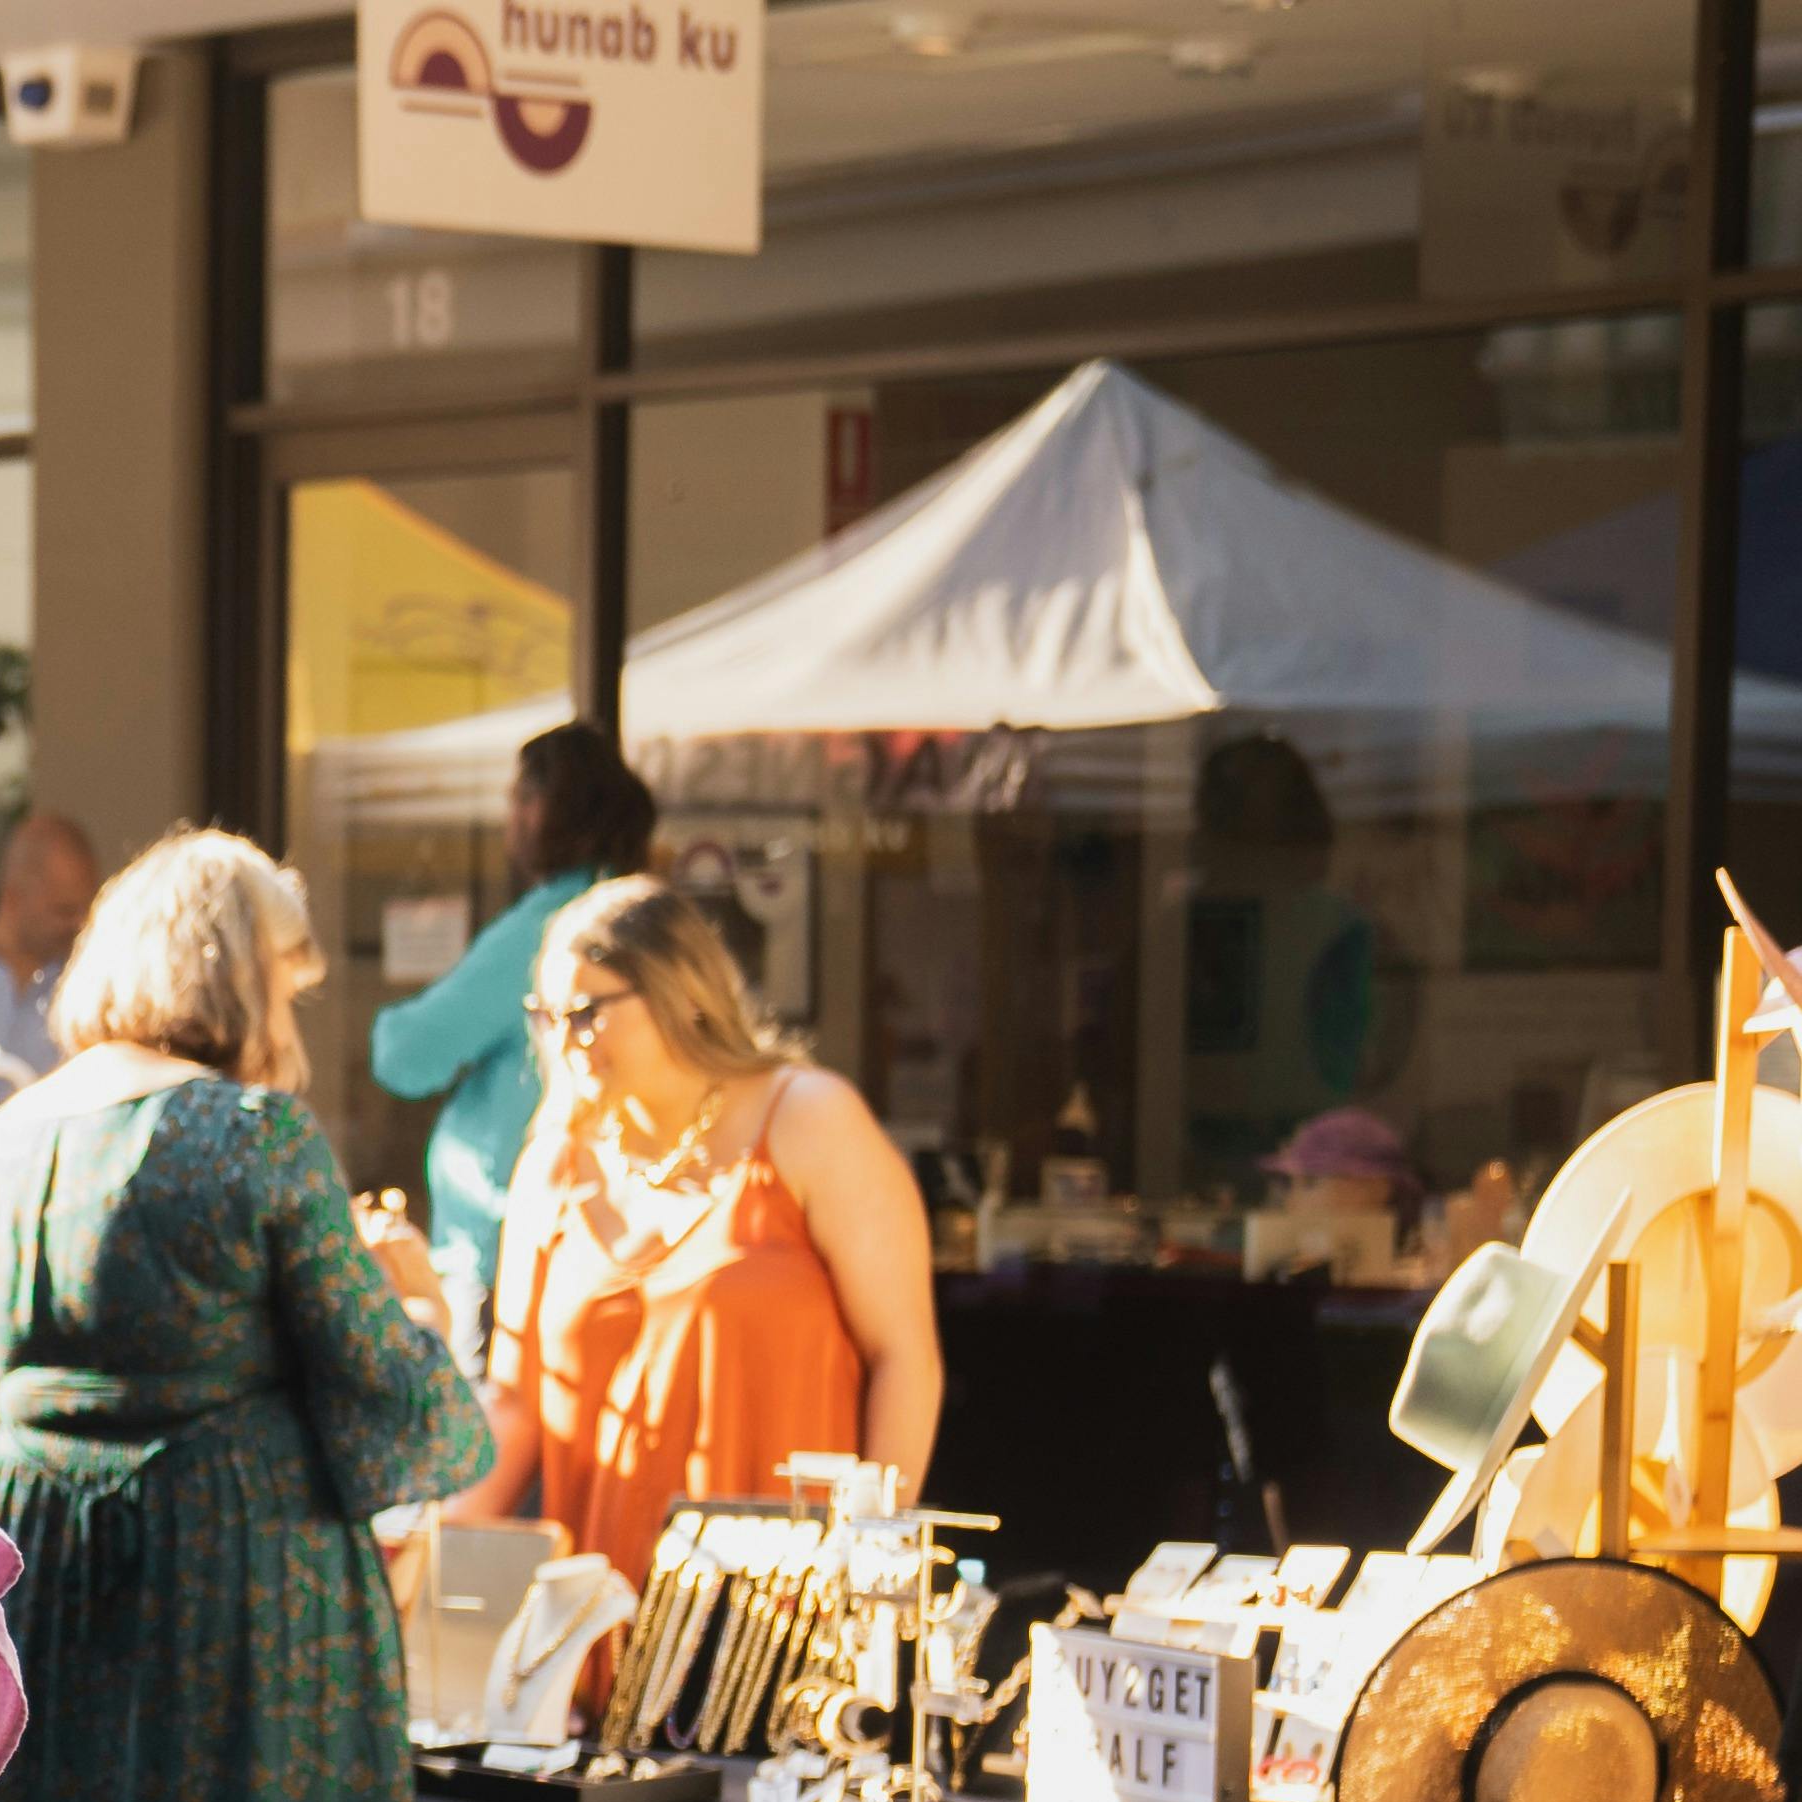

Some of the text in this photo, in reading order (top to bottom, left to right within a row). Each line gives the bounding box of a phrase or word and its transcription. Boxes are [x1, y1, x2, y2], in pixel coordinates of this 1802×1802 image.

[500, 0, 737, 75] hunab ku
[388, 270, 452, 349] 18
